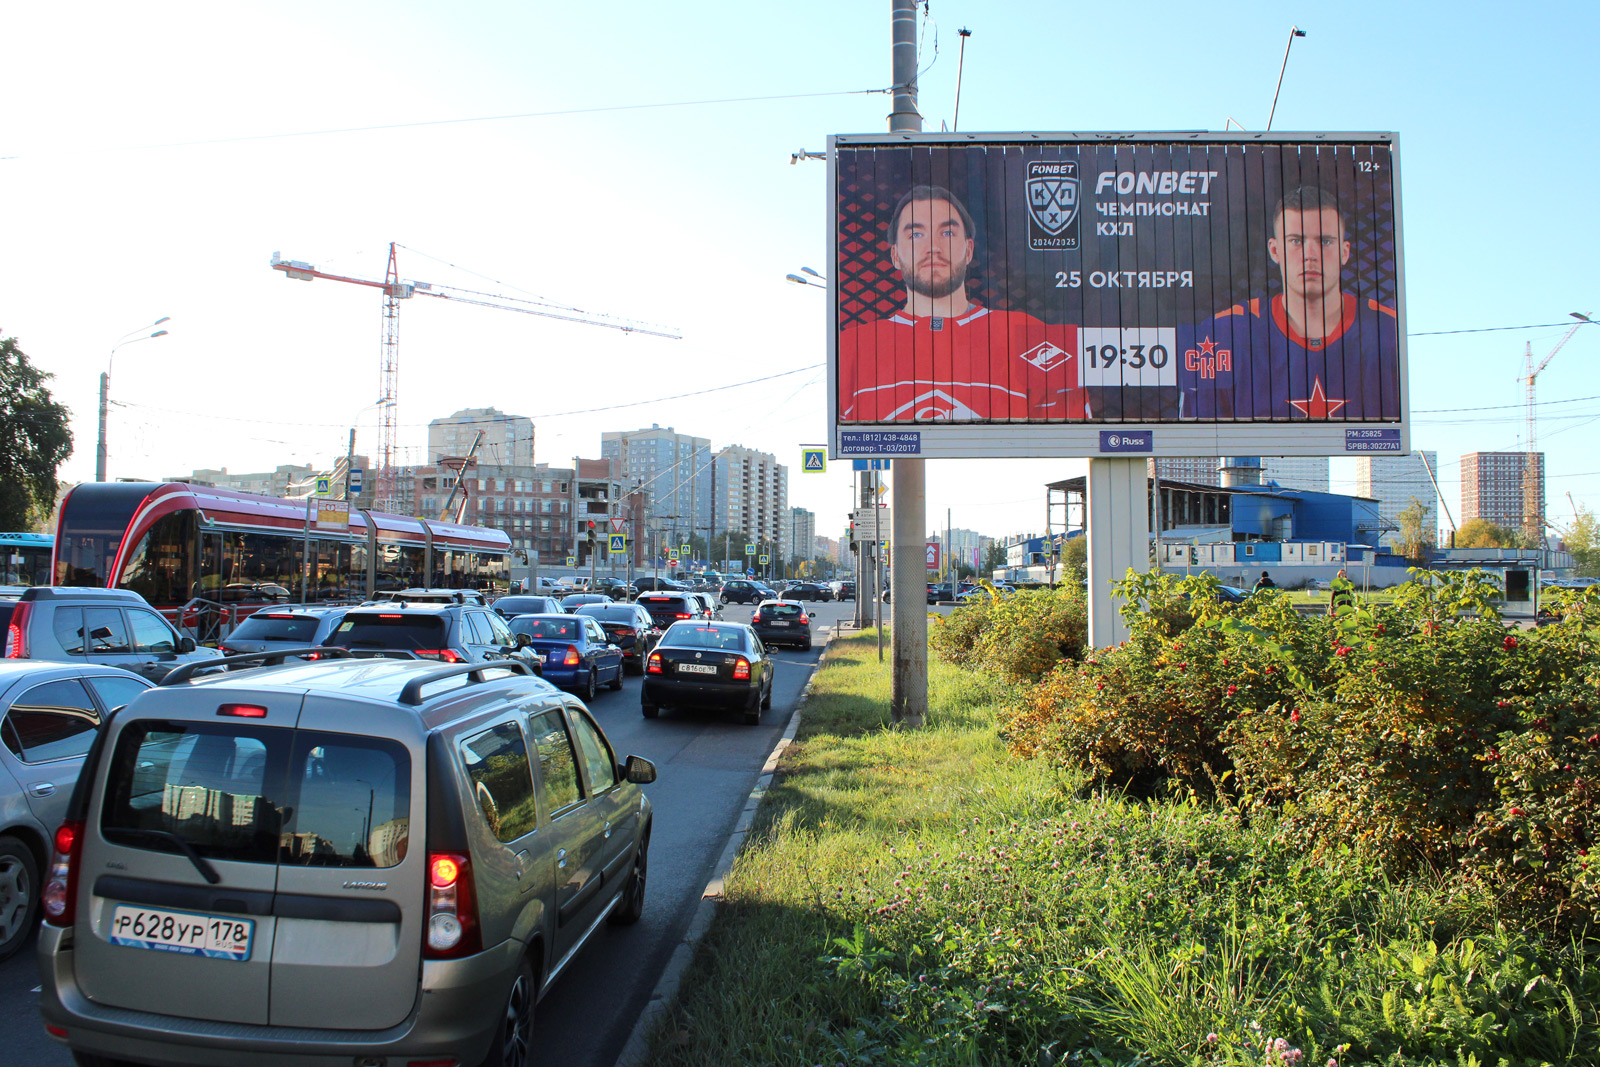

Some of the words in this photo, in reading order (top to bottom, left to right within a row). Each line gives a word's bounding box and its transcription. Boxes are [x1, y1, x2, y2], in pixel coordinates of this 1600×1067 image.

[1031, 165, 1074, 174] FONBET
[1358, 161, 1380, 172] 12+
[1095, 171, 1218, 195] FONBET
[1095, 201, 1212, 216] ЧЕМПИОНАТ
[1096, 222, 1134, 236] КХЛ
[1033, 238, 1076, 246] 2024/2025
[1055, 271, 1081, 288] 25
[1089, 270, 1193, 288] ОКТЯБРЯ
[1085, 344, 1168, 369] 19:30
[862, 433, 881, 441] (812)
[1122, 437, 1145, 445] Russ
[843, 445, 877, 453] договор:
[118, 912, 204, 944] Р628УР
[210, 921, 245, 942] 178
